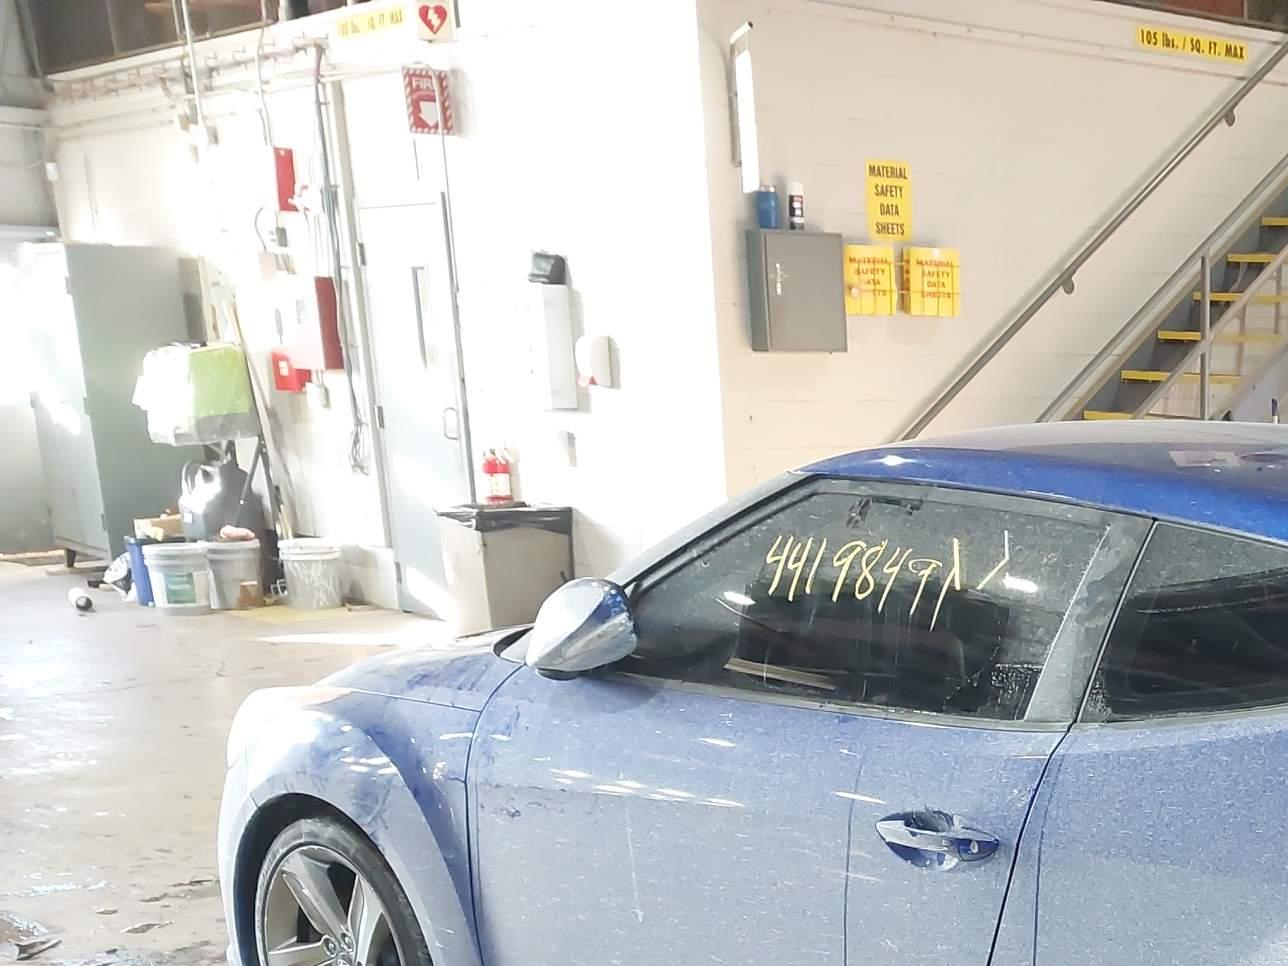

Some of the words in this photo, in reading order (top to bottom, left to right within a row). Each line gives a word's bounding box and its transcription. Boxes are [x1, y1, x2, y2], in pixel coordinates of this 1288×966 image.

[1140, 29, 1158, 46] 105
[1162, 32, 1179, 49] lbs.
[1182, 36, 1187, 51] /
[1190, 37, 1205, 54] SQ.
[1208, 41, 1221, 56] FT.
[1224, 43, 1245, 60] MAX
[412, 76, 435, 90] FIR
[868, 164, 908, 180] MATERIAL
[874, 184, 904, 198] SAFETY
[879, 203, 900, 217] DATA
[875, 221, 905, 236] SHEETS
[848, 256, 889, 265] MATERIAL
[916, 259, 954, 267] MATERIAL
[922, 270, 951, 279] SAFETY
[927, 280, 946, 288] DATA
